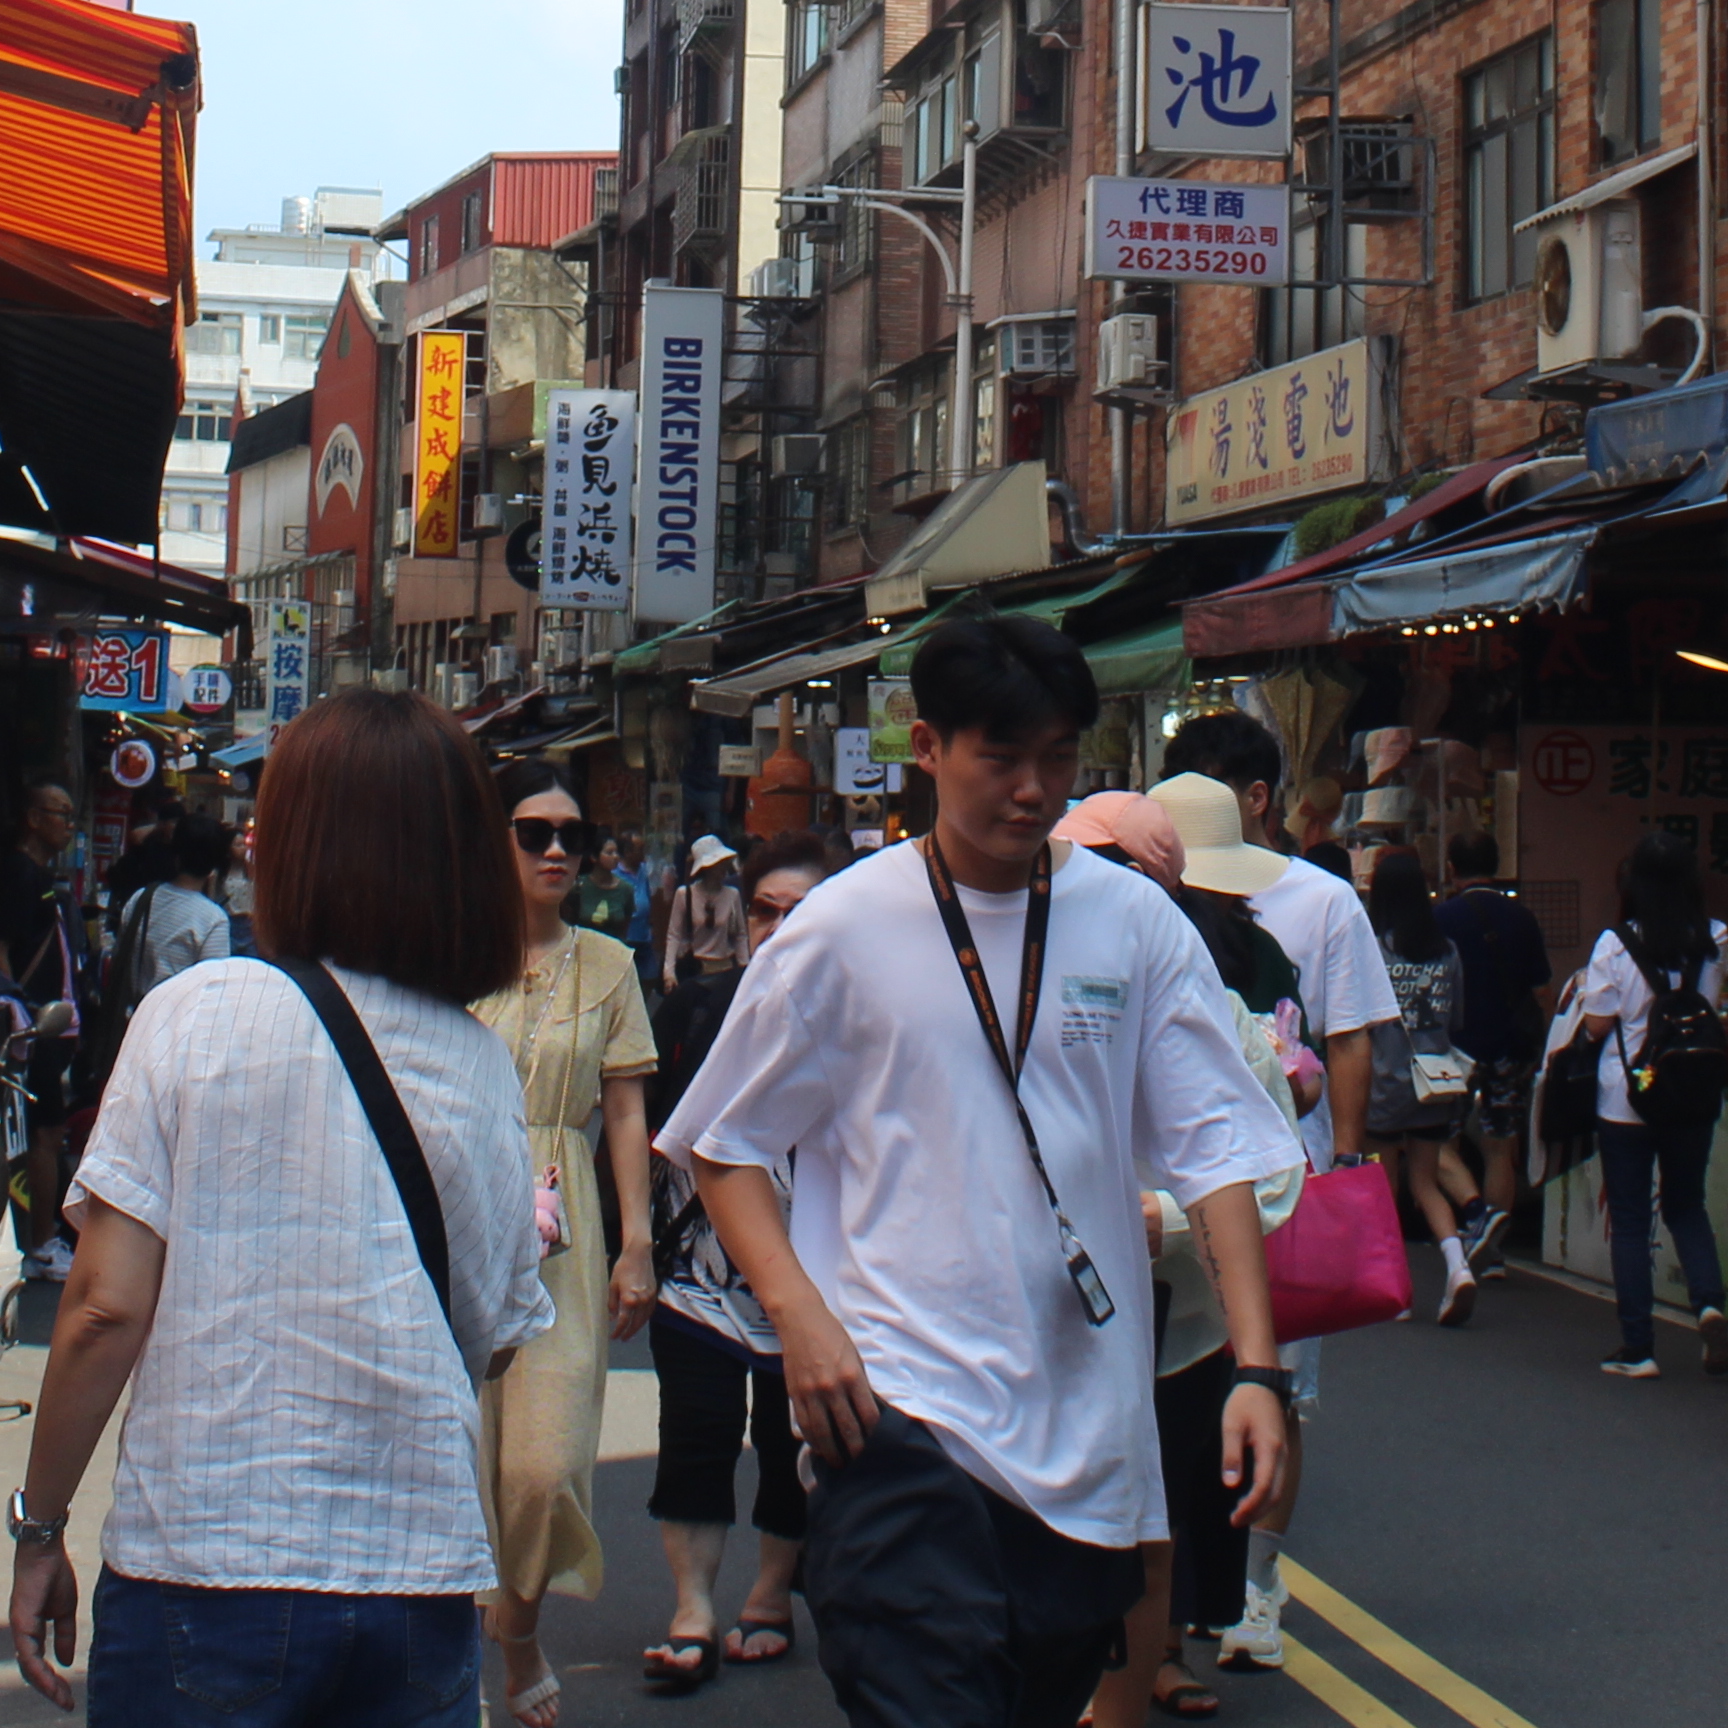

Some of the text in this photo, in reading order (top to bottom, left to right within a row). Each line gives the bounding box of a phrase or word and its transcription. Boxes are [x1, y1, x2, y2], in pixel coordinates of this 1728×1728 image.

[1139, 185, 1245, 220] 代理商
[1105, 219, 1278, 247] 久捷實業有限公司
[1117, 246, 1267, 275] 26235290
[1208, 357, 1354, 479] 湯淺電池
[421, 344, 460, 545] 新建成餅店
[655, 336, 703, 575] BIRKENSTOCK
[1311, 453, 1354, 480] 26235290
[1177, 481, 1198, 506] YUASA
[271, 642, 304, 722] 按摩
